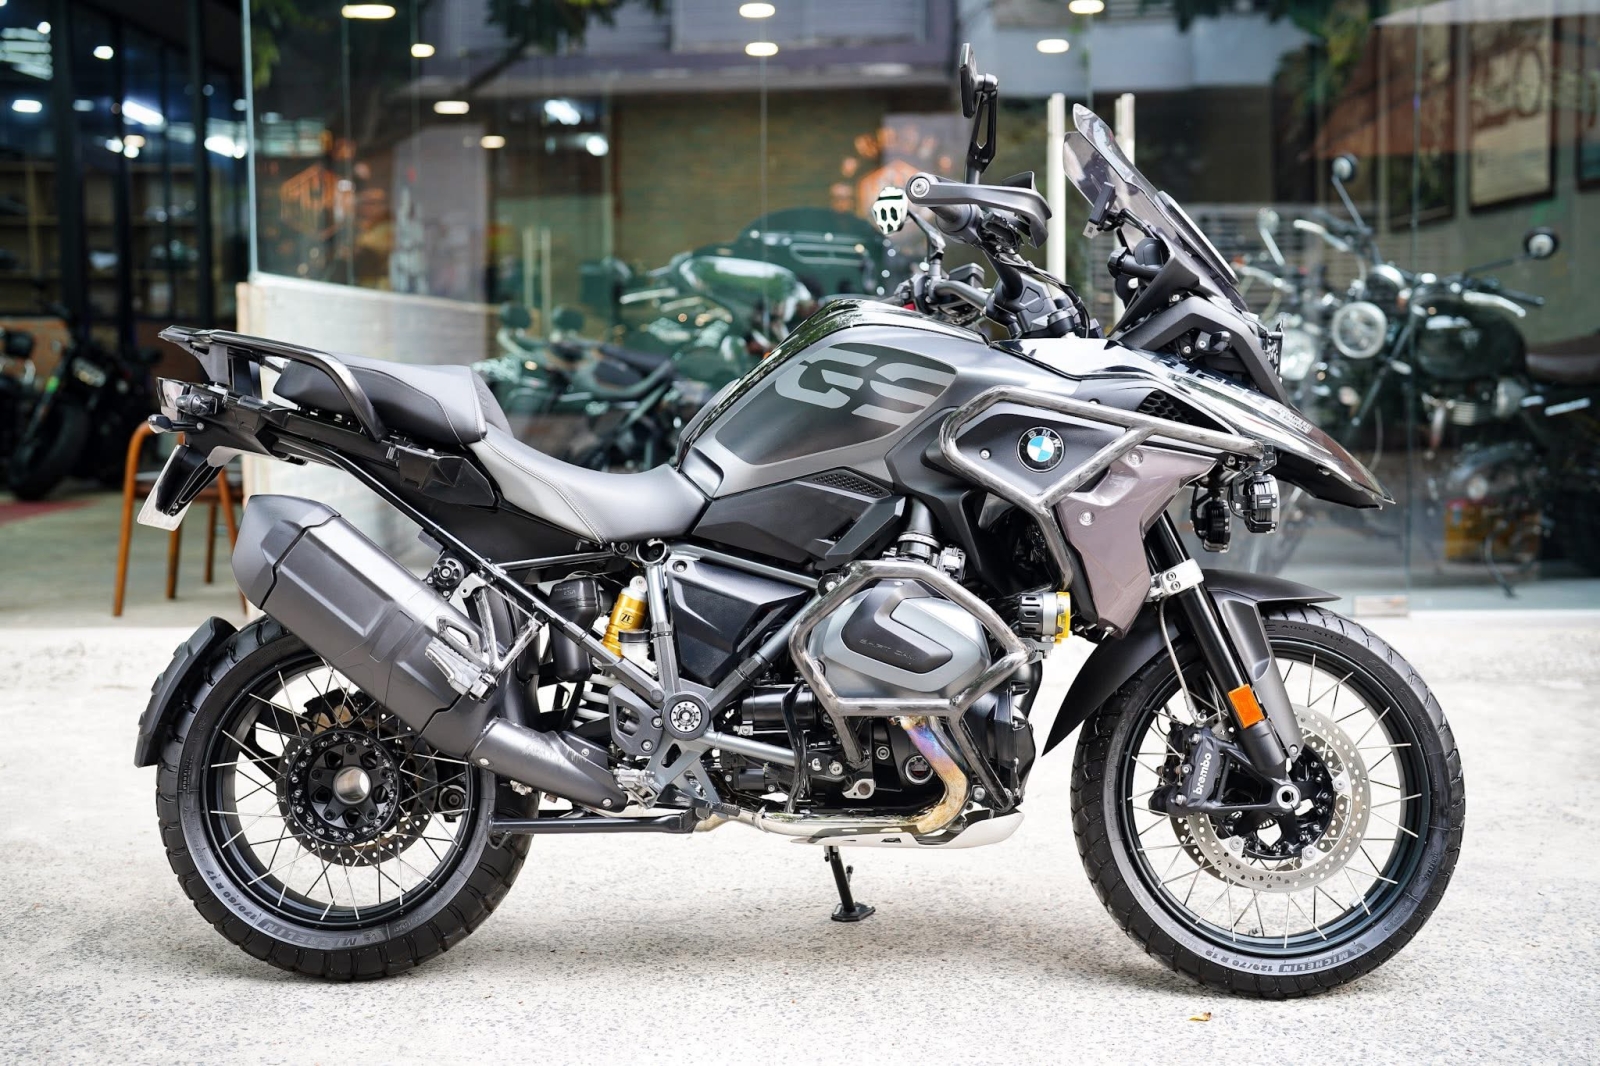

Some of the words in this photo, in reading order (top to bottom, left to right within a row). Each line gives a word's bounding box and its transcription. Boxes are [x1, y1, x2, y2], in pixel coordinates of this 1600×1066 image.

[774, 347, 957, 427] GS
[1027, 429, 1062, 448] BMW
[1281, 624, 1349, 646] ADVNTUR
[1192, 752, 1212, 795] brembo
[205, 870, 217, 881] 17
[215, 882, 225, 890] R
[222, 891, 257, 920] 170/60
[1205, 949, 1219, 959] 19
[1282, 951, 1349, 973] MICHELIN
